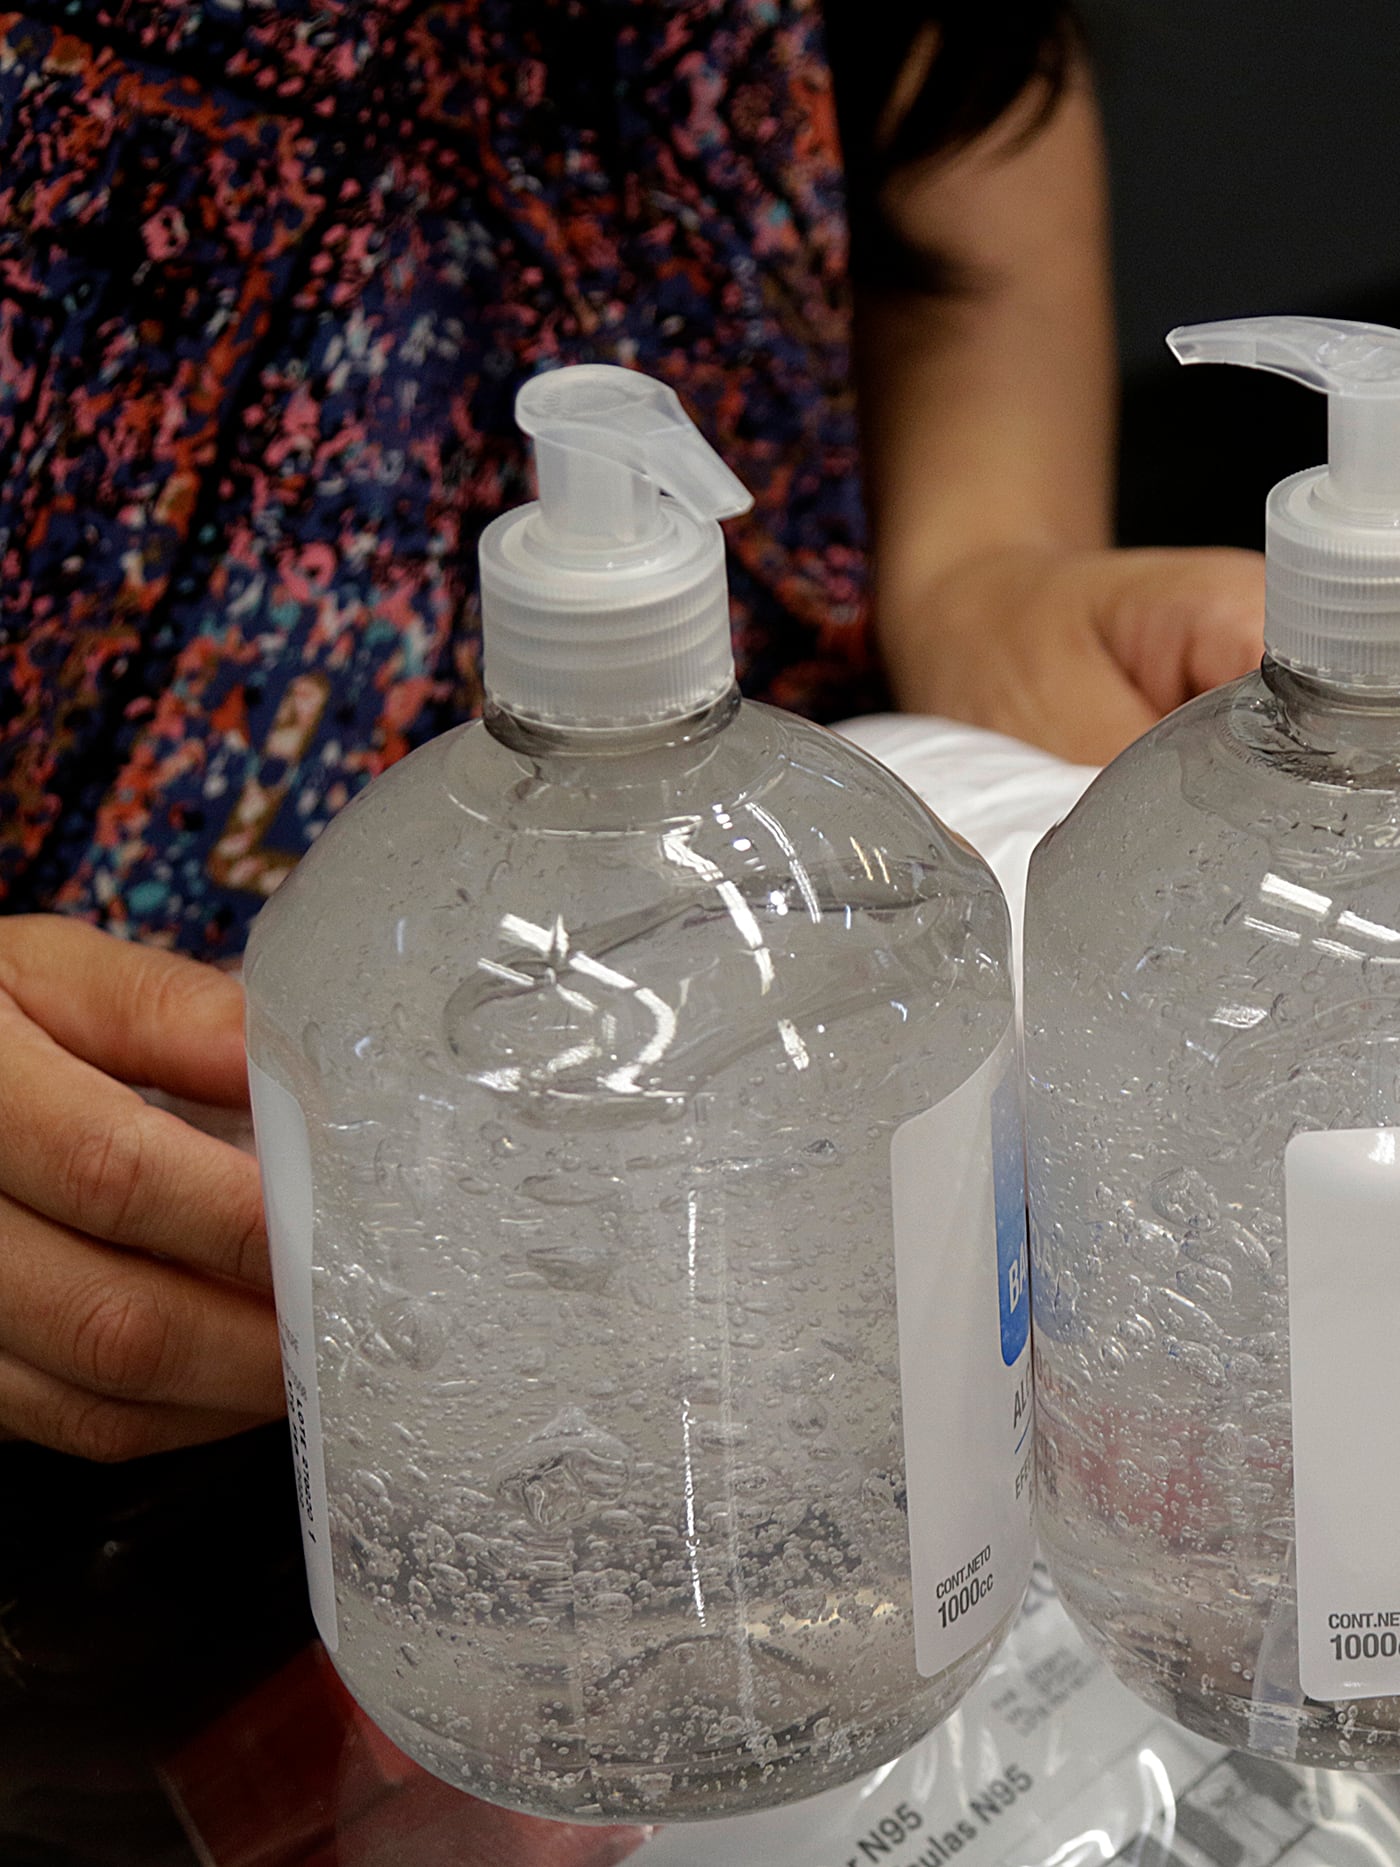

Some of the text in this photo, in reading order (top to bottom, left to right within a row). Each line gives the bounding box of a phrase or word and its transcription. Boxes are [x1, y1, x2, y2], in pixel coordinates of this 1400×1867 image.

[296, 1398, 308, 1450] LOTE
[936, 1544, 991, 1599] CONT.NETO
[938, 1573, 994, 1629] 1000cc
[969, 1763, 1034, 1825] N95
[857, 1802, 923, 1864] N95
